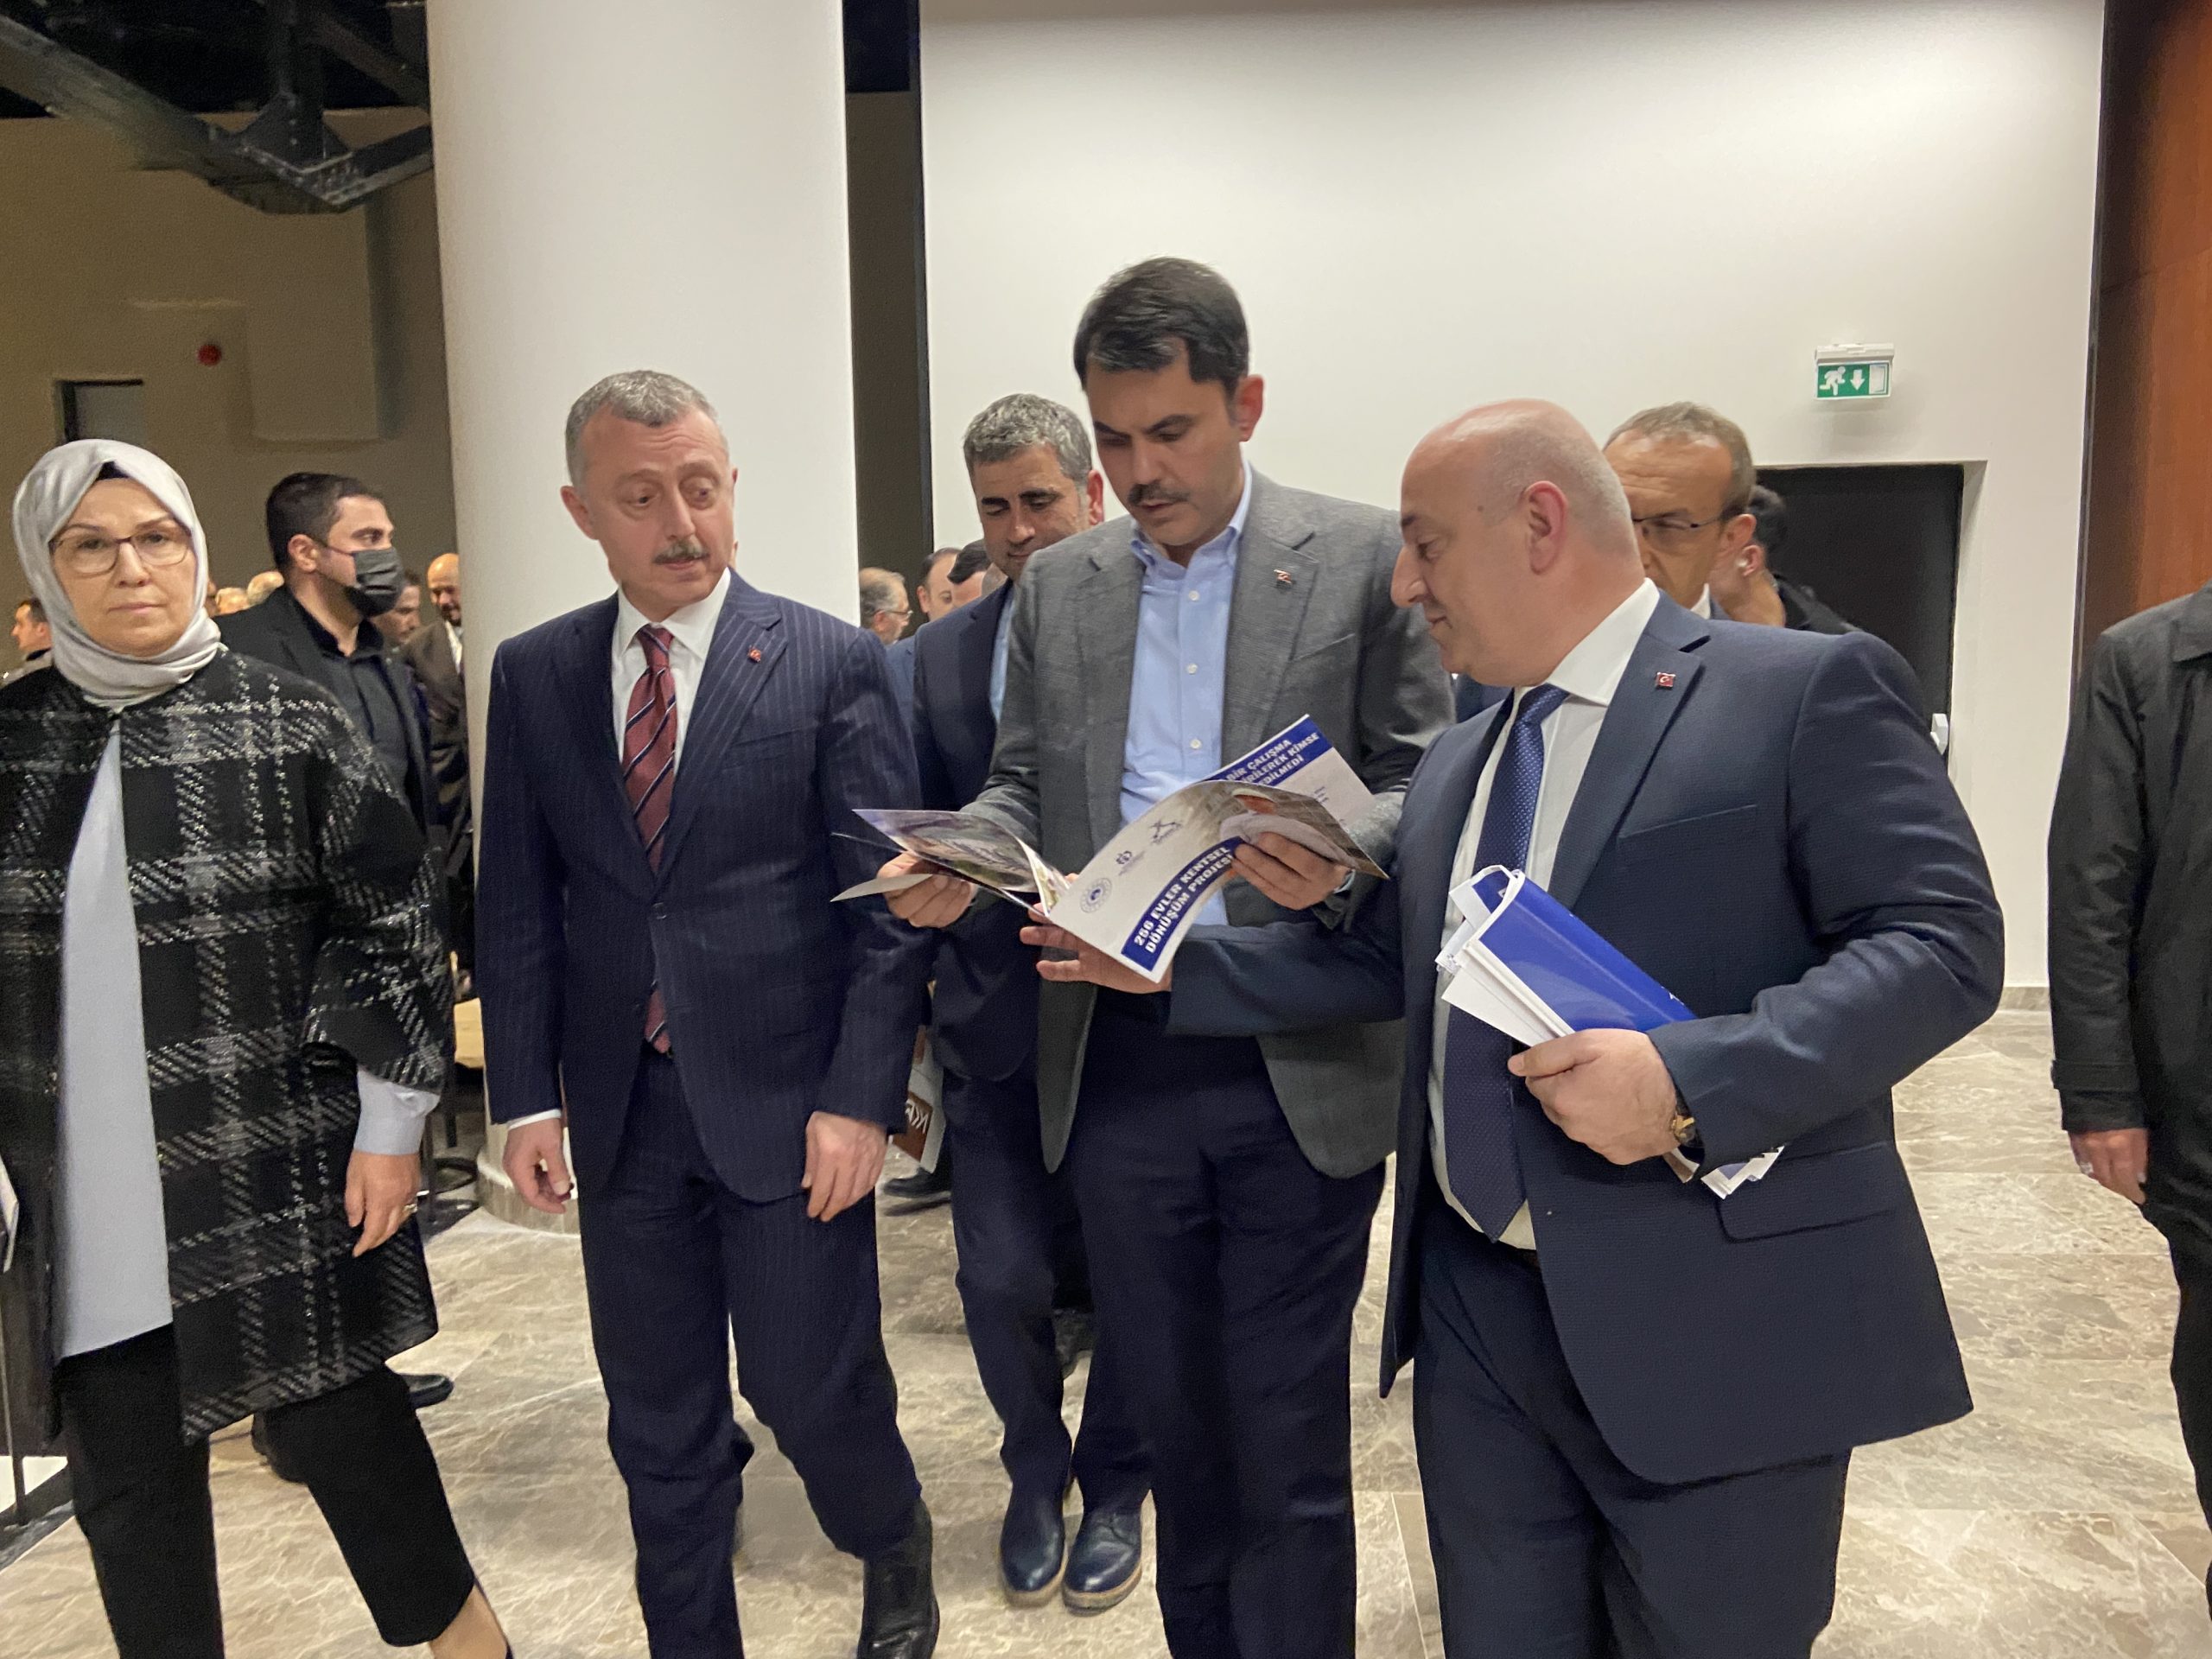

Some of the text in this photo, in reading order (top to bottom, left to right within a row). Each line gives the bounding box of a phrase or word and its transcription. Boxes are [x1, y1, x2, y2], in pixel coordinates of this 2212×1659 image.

[1225, 739, 1293, 780] BİR ÇALIŞMA
[1241, 732, 1320, 783] İRİLEREK KİMSE
[1150, 883, 1182, 920] EVLER
[1179, 847, 1230, 884] KENTSEL
[1145, 892, 1191, 954] DÖNÜŞÜM
